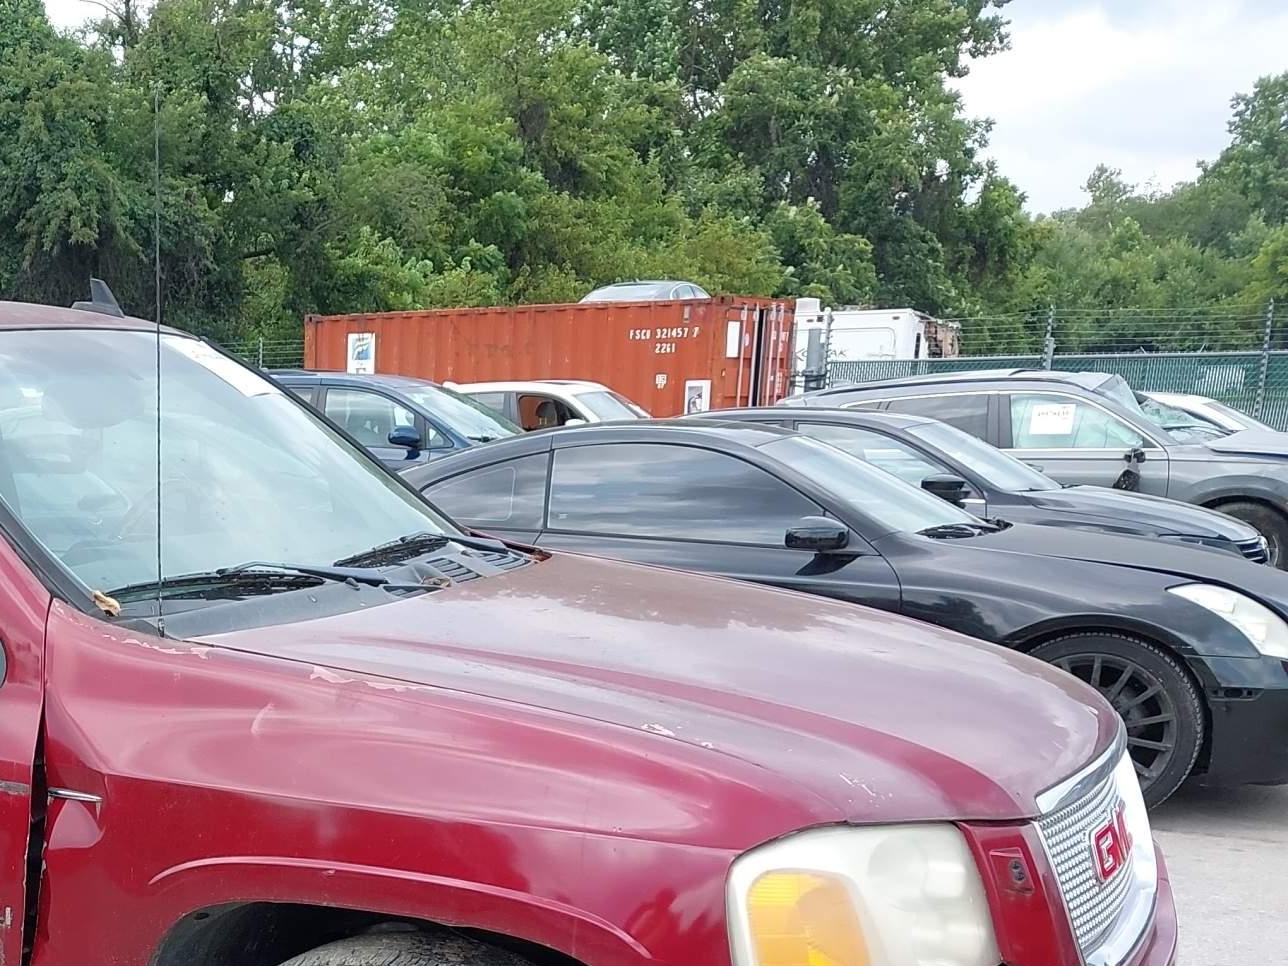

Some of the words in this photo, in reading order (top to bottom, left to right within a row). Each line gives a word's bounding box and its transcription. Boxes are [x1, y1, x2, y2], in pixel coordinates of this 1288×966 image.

[629, 329, 651, 340] FSCU
[655, 327, 689, 339] 321457
[692, 326, 700, 338] 7
[1094, 799, 1133, 881] GM
